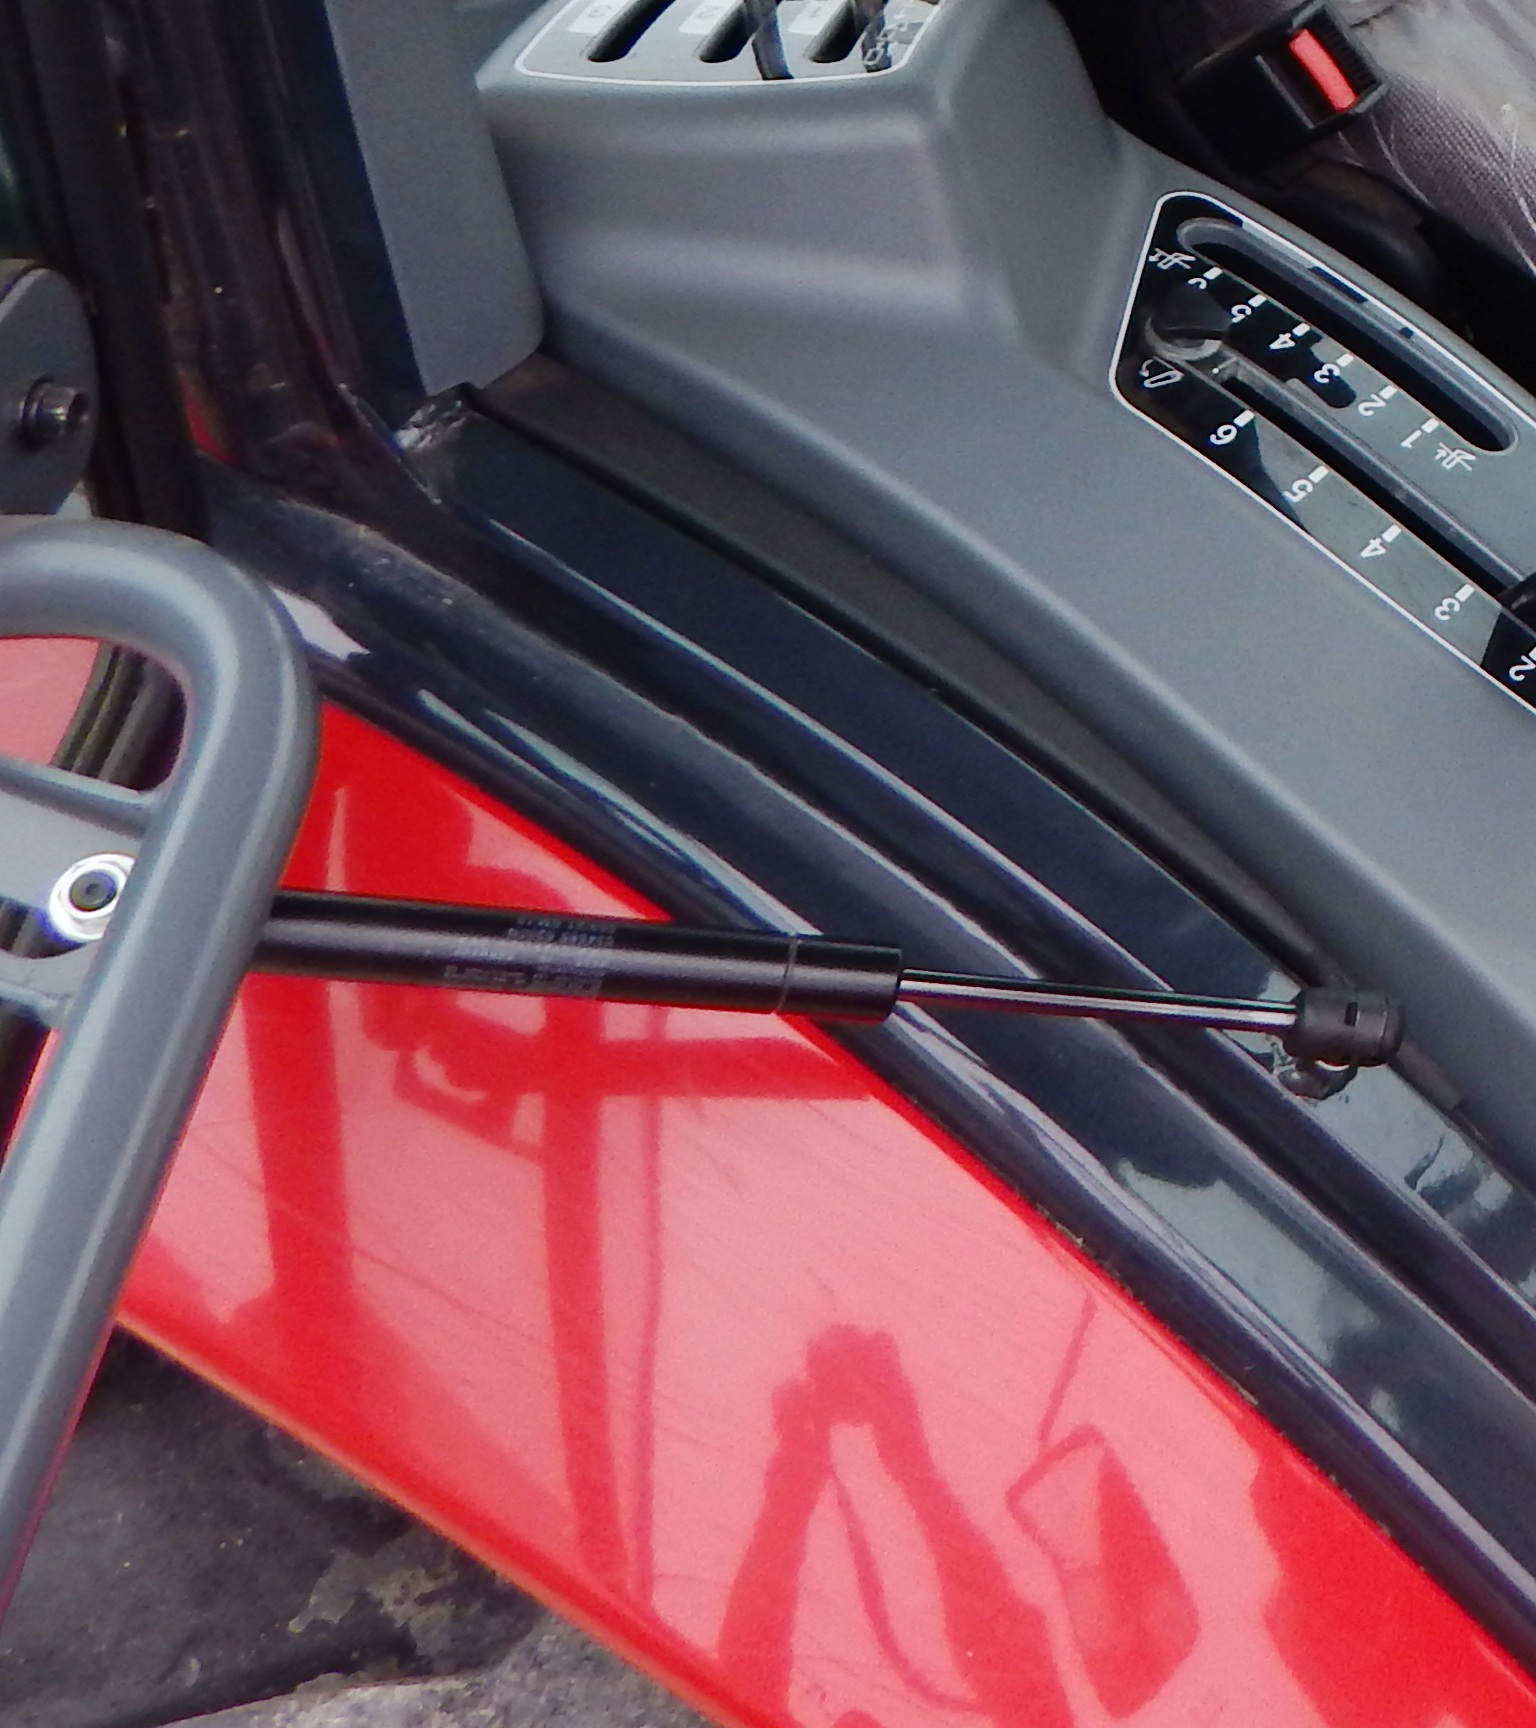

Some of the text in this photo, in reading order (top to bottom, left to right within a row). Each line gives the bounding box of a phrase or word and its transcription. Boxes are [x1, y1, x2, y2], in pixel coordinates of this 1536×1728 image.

[1269, 332, 1295, 350] 4
[1313, 363, 1340, 384] 3
[1357, 393, 1386, 416] 2
[1401, 429, 1422, 449] 1
[1282, 478, 1313, 503] 5
[1360, 537, 1386, 558] 4
[1434, 597, 1461, 621] 3
[1508, 654, 1536, 682] 2
